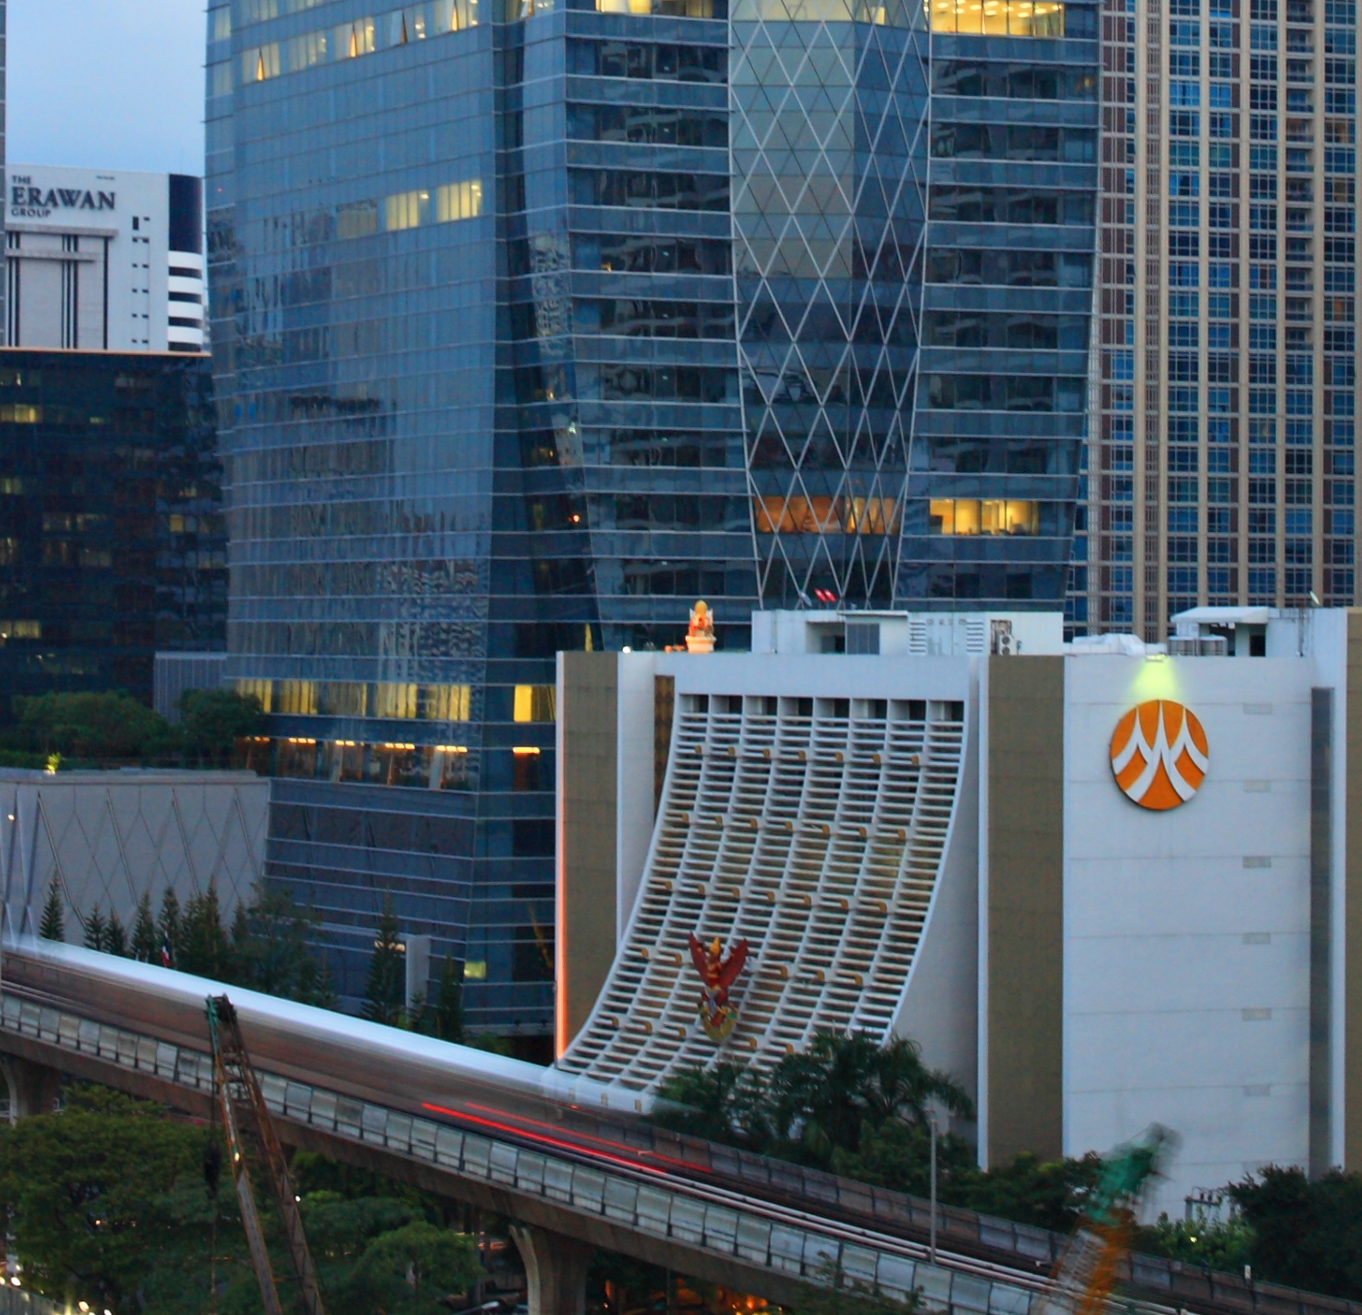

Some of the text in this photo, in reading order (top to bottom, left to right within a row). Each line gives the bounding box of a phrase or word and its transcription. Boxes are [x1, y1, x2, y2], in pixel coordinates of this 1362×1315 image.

[12, 175, 31, 184] THE
[11, 186, 116, 210] ERAWAN
[11, 208, 51, 218] GROUP
